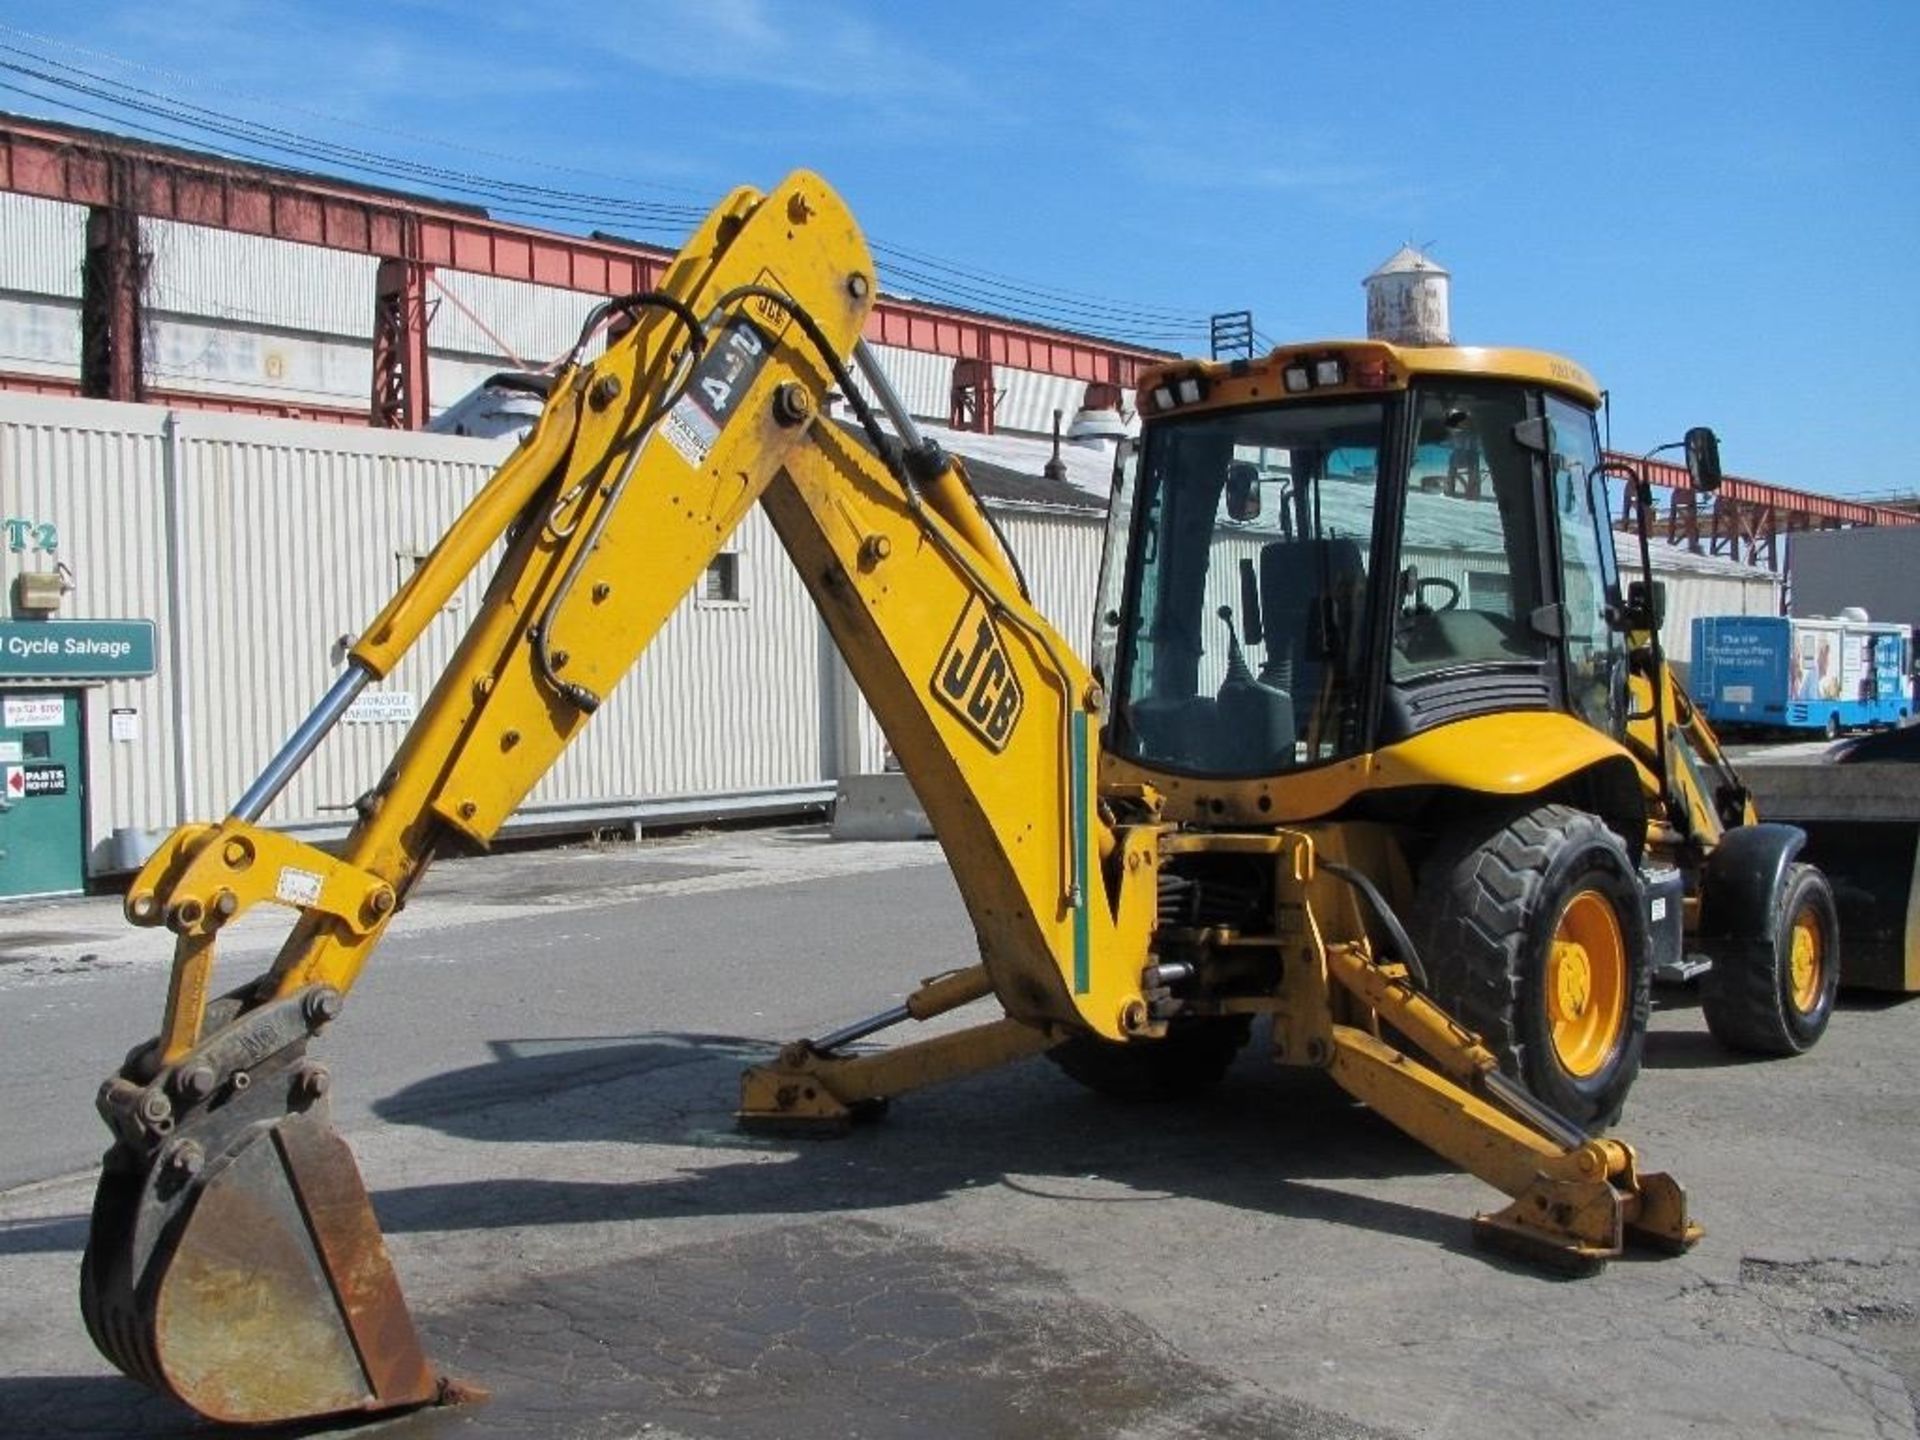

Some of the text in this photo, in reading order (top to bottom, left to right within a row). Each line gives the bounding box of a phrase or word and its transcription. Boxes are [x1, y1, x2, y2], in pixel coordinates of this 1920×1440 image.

[8, 636, 59, 657] Cycle
[64, 637, 131, 658] Salvage
[942, 615, 1019, 742] JCB
[26, 770, 64, 780] PARTS
